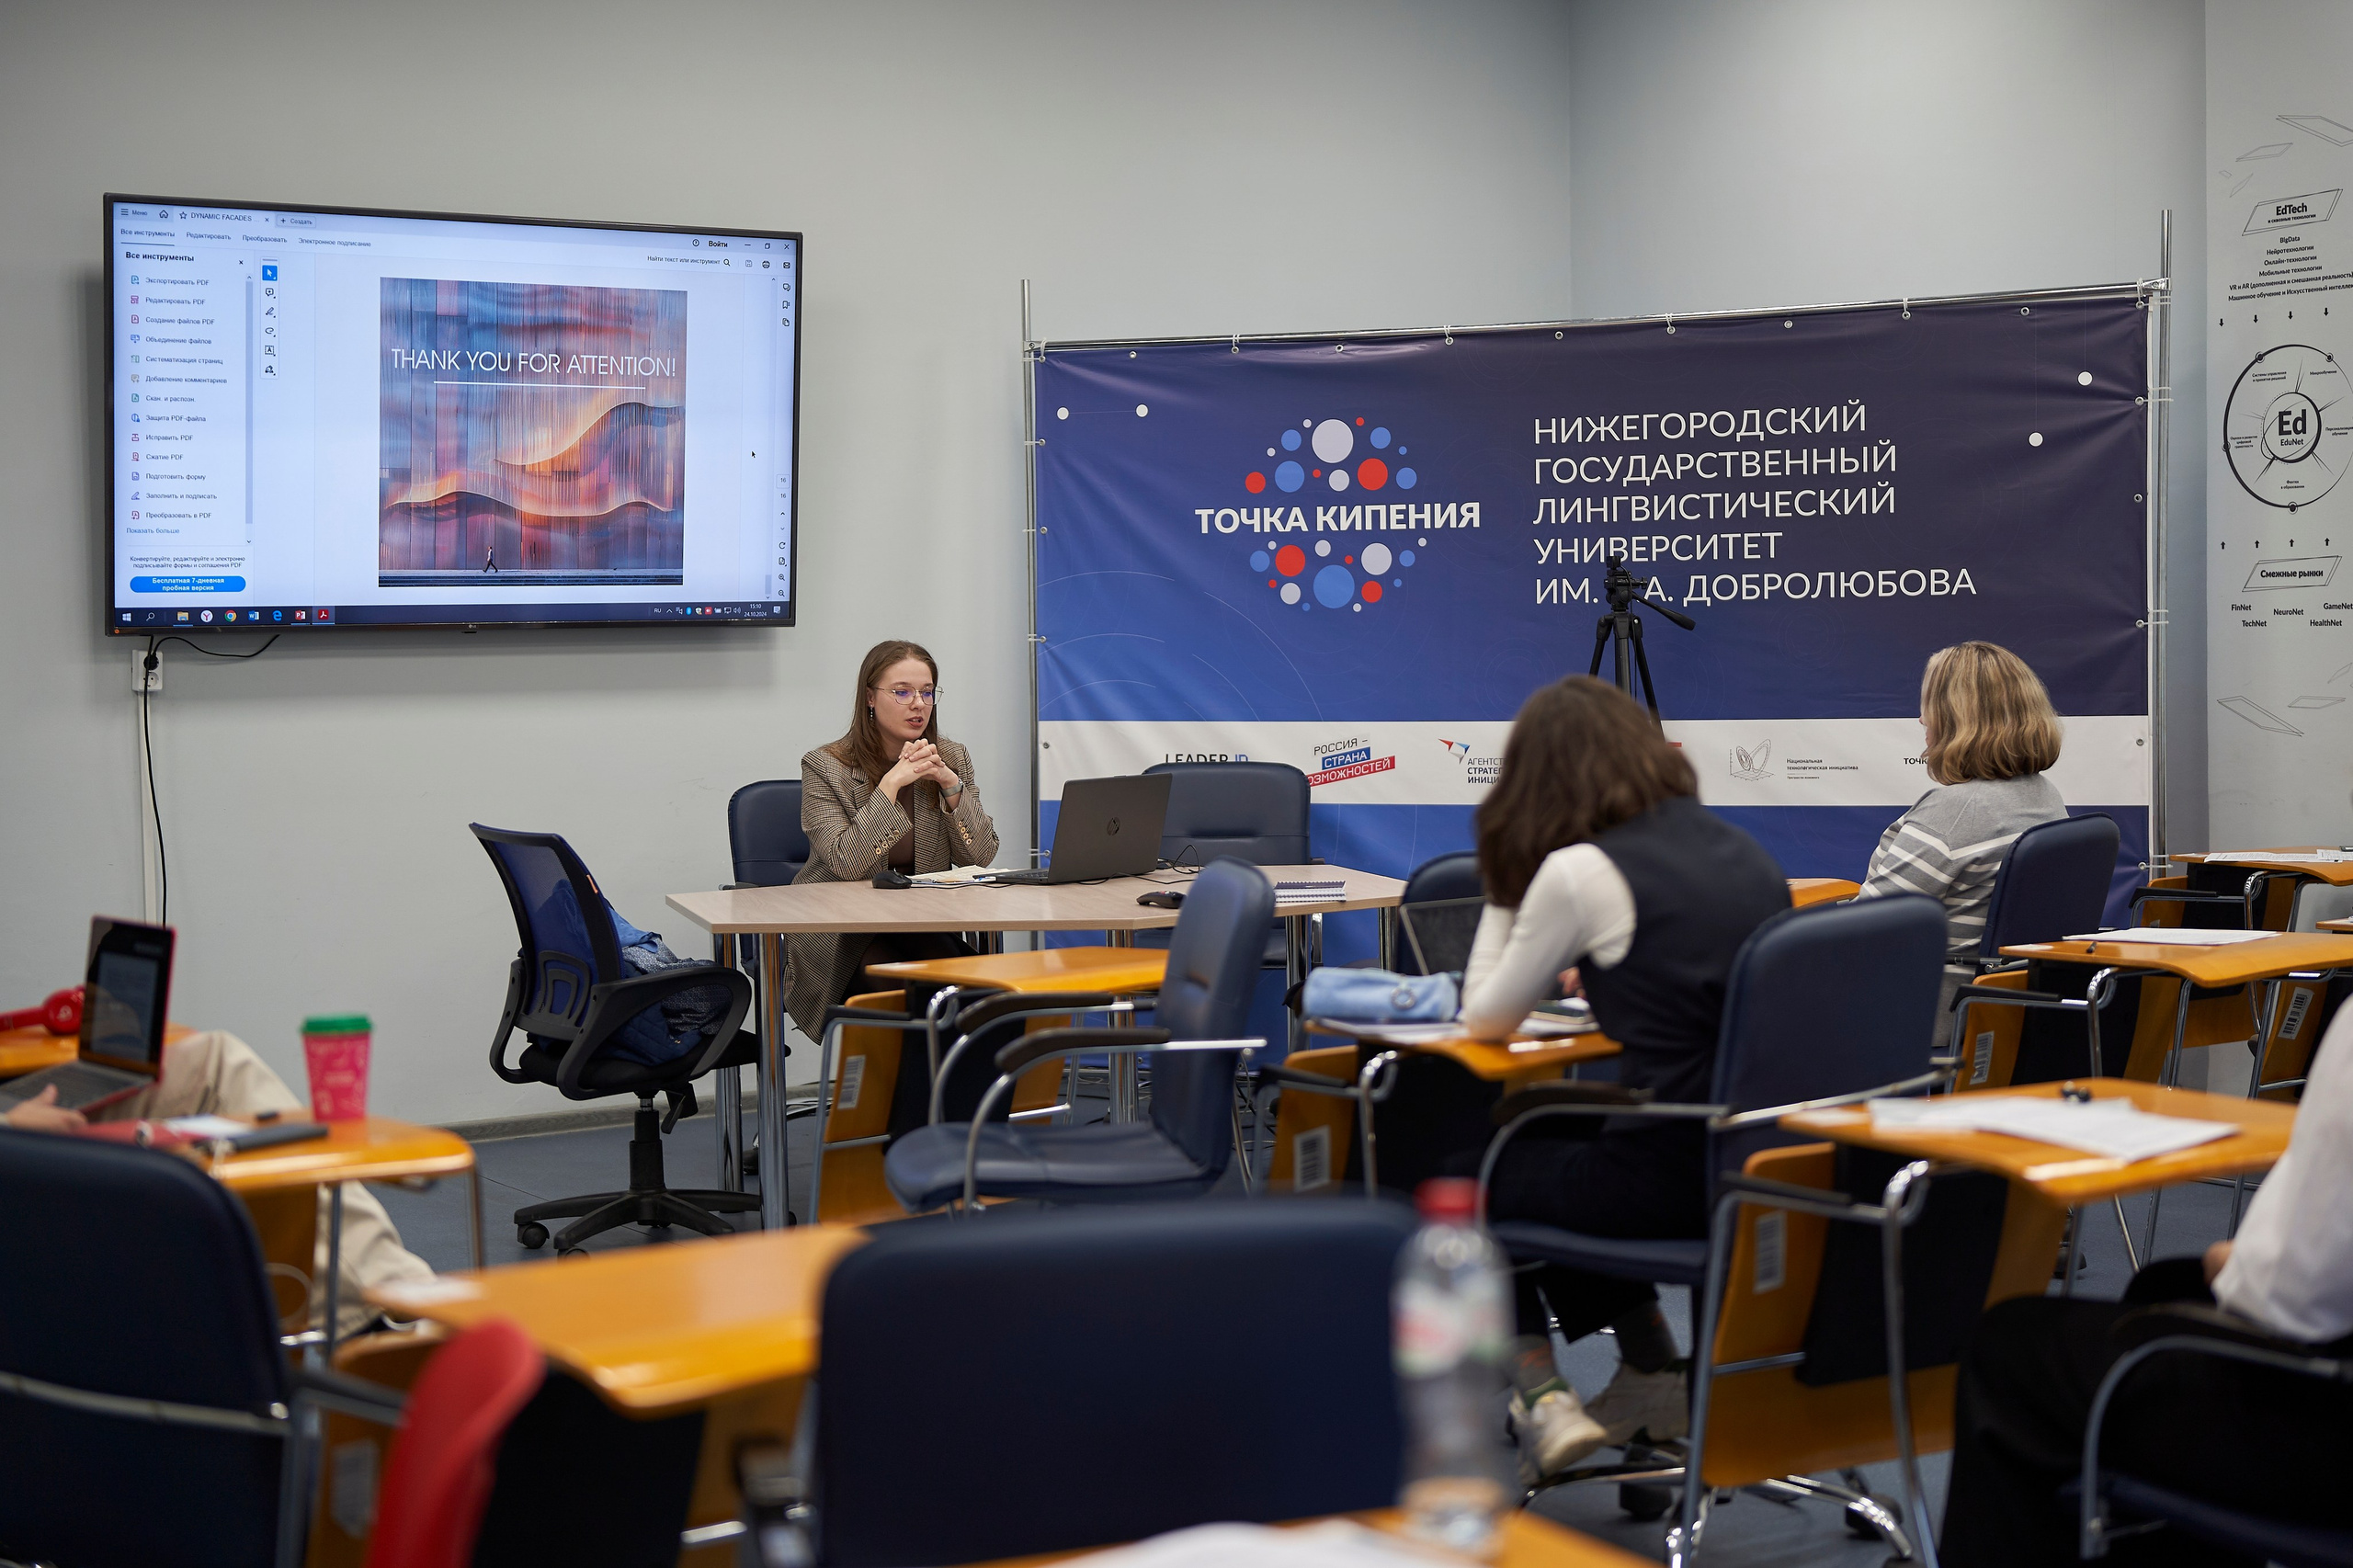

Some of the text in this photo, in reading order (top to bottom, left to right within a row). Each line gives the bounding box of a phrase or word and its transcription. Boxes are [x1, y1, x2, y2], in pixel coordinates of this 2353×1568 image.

[2276, 202, 2308, 216] EdTech
[190, 211, 252, 222] DYNAMIC FACADES
[290, 218, 313, 226] Создать
[120, 228, 175, 239] Все инструменты
[186, 232, 231, 242] Редактировать
[243, 235, 287, 244] Преобразовать
[298, 237, 371, 249] Электронное подписание
[2267, 245, 2314, 256] Нейротехнологии
[126, 251, 195, 263] Все инструменты
[2264, 256, 2317, 266] Онлайн-технологии
[2258, 265, 2322, 277] Мобильные технологии
[145, 277, 210, 287] Экспортировать PDF
[2250, 279, 2286, 290] (дополненная
[2256, 290, 2280, 299] обучение
[2287, 285, 2328, 295] Искусственный
[145, 297, 206, 307] Редактировать PDF
[145, 316, 215, 326] Создание файлов PDF
[145, 335, 211, 346] Объединение файлов
[145, 356, 223, 366] Систематизация страниц
[391, 348, 676, 377] THANK YOU FOR ATTENTION!
[145, 375, 183, 383] Добавление
[145, 415, 206, 423] Защита PDF-файла
[1534, 398, 1867, 444] НИЖЕГОРОДСКИЙ
[2278, 409, 2307, 436] Ed
[145, 434, 178, 442] Исправить
[2280, 437, 2304, 447] EduNet
[1535, 439, 1897, 487] ГОСУДАРСТВЕННЫЙ
[145, 472, 206, 482] Подготовить форму
[1533, 481, 1896, 525] ЛИНГВИСТИЧЕСКИЙ
[145, 512, 192, 520] Преобразовать
[1195, 502, 1482, 534] ТОЧКА КИПЕНИЯ
[1533, 531, 1783, 564] УНИВЕРСИТЕТ
[130, 555, 173, 563] Конвертируйте,
[2260, 569, 2324, 579] Смежные рынки
[191, 577, 225, 585] 7-дневная
[1536, 577, 1599, 605] ИМ.
[1684, 568, 1978, 608] ДОБРОЛЮБОВА
[2231, 604, 2252, 612] FinNet
[2242, 619, 2268, 628] TechNet
[1313, 738, 1358, 756] РОССИЯ
[1324, 751, 1367, 767] СТРАНА
[1467, 757, 1506, 766] АГЕНТСТ
[1307, 757, 1391, 784] ОЗМОЖНОСТЕЙ
[1467, 767, 1503, 775] СТРАТЕГ
[1467, 776, 1500, 785] ИНИЦИ
